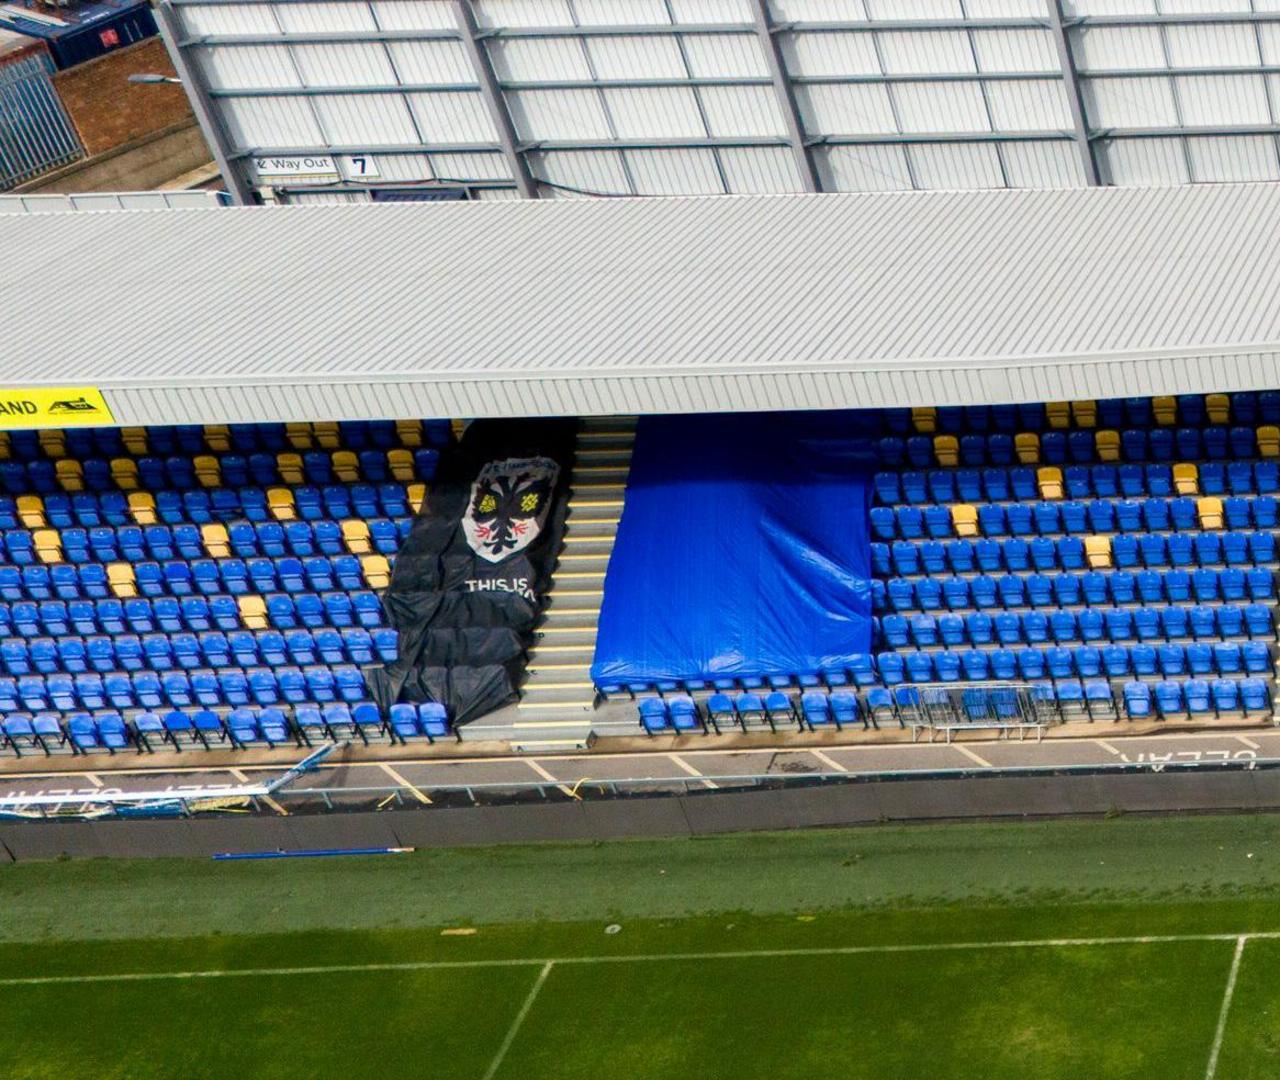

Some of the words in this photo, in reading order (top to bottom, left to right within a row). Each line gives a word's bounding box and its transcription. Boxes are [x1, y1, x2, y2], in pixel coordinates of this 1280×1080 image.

[272, 160, 300, 171] Way
[303, 158, 329, 168] Out
[352, 158, 366, 174] 7
[465, 580, 509, 592] THIS
[514, 578, 528, 590] IS
